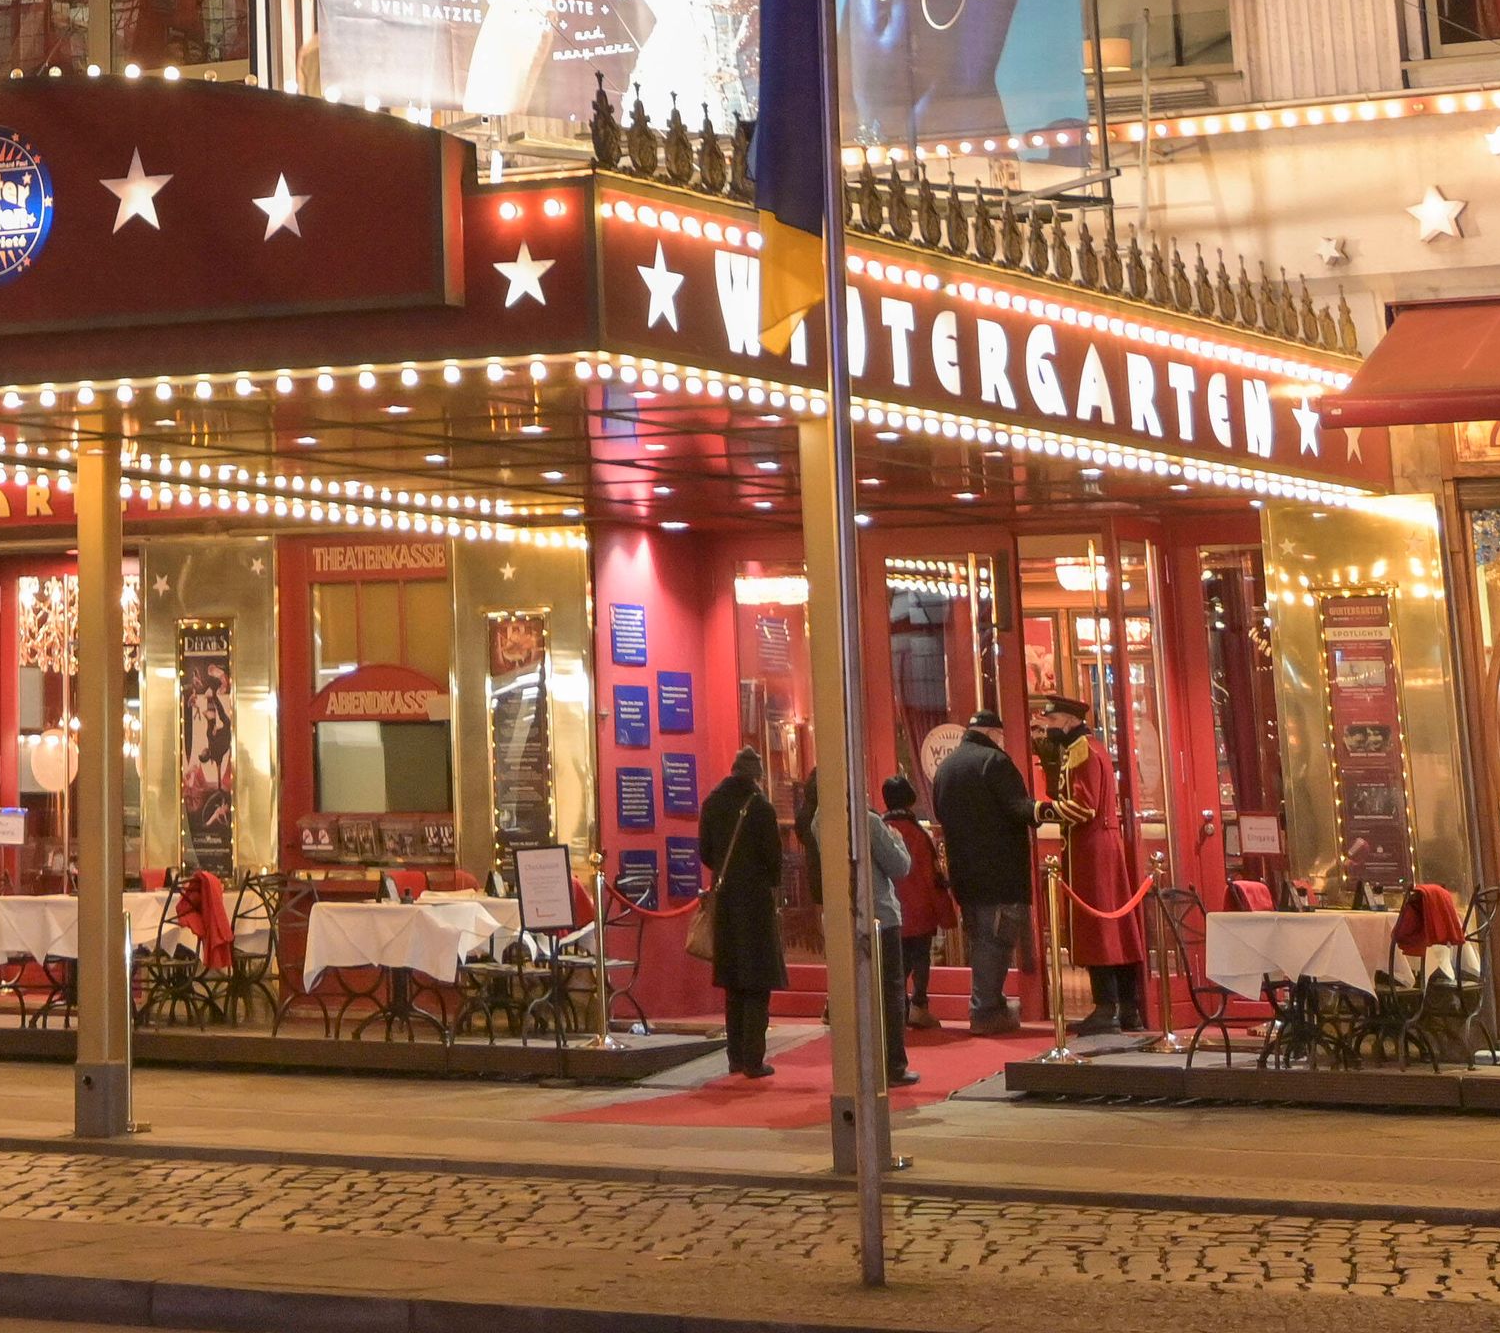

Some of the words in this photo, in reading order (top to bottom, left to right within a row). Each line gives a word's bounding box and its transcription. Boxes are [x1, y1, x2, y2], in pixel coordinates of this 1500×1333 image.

[371, 0, 416, 19] SVEN
[422, 3, 482, 23] RATZKE
[312, 544, 447, 572] THEATERKASSE
[1332, 629, 1384, 638] SPOTLIGHTS
[930, 745, 955, 758] Win
